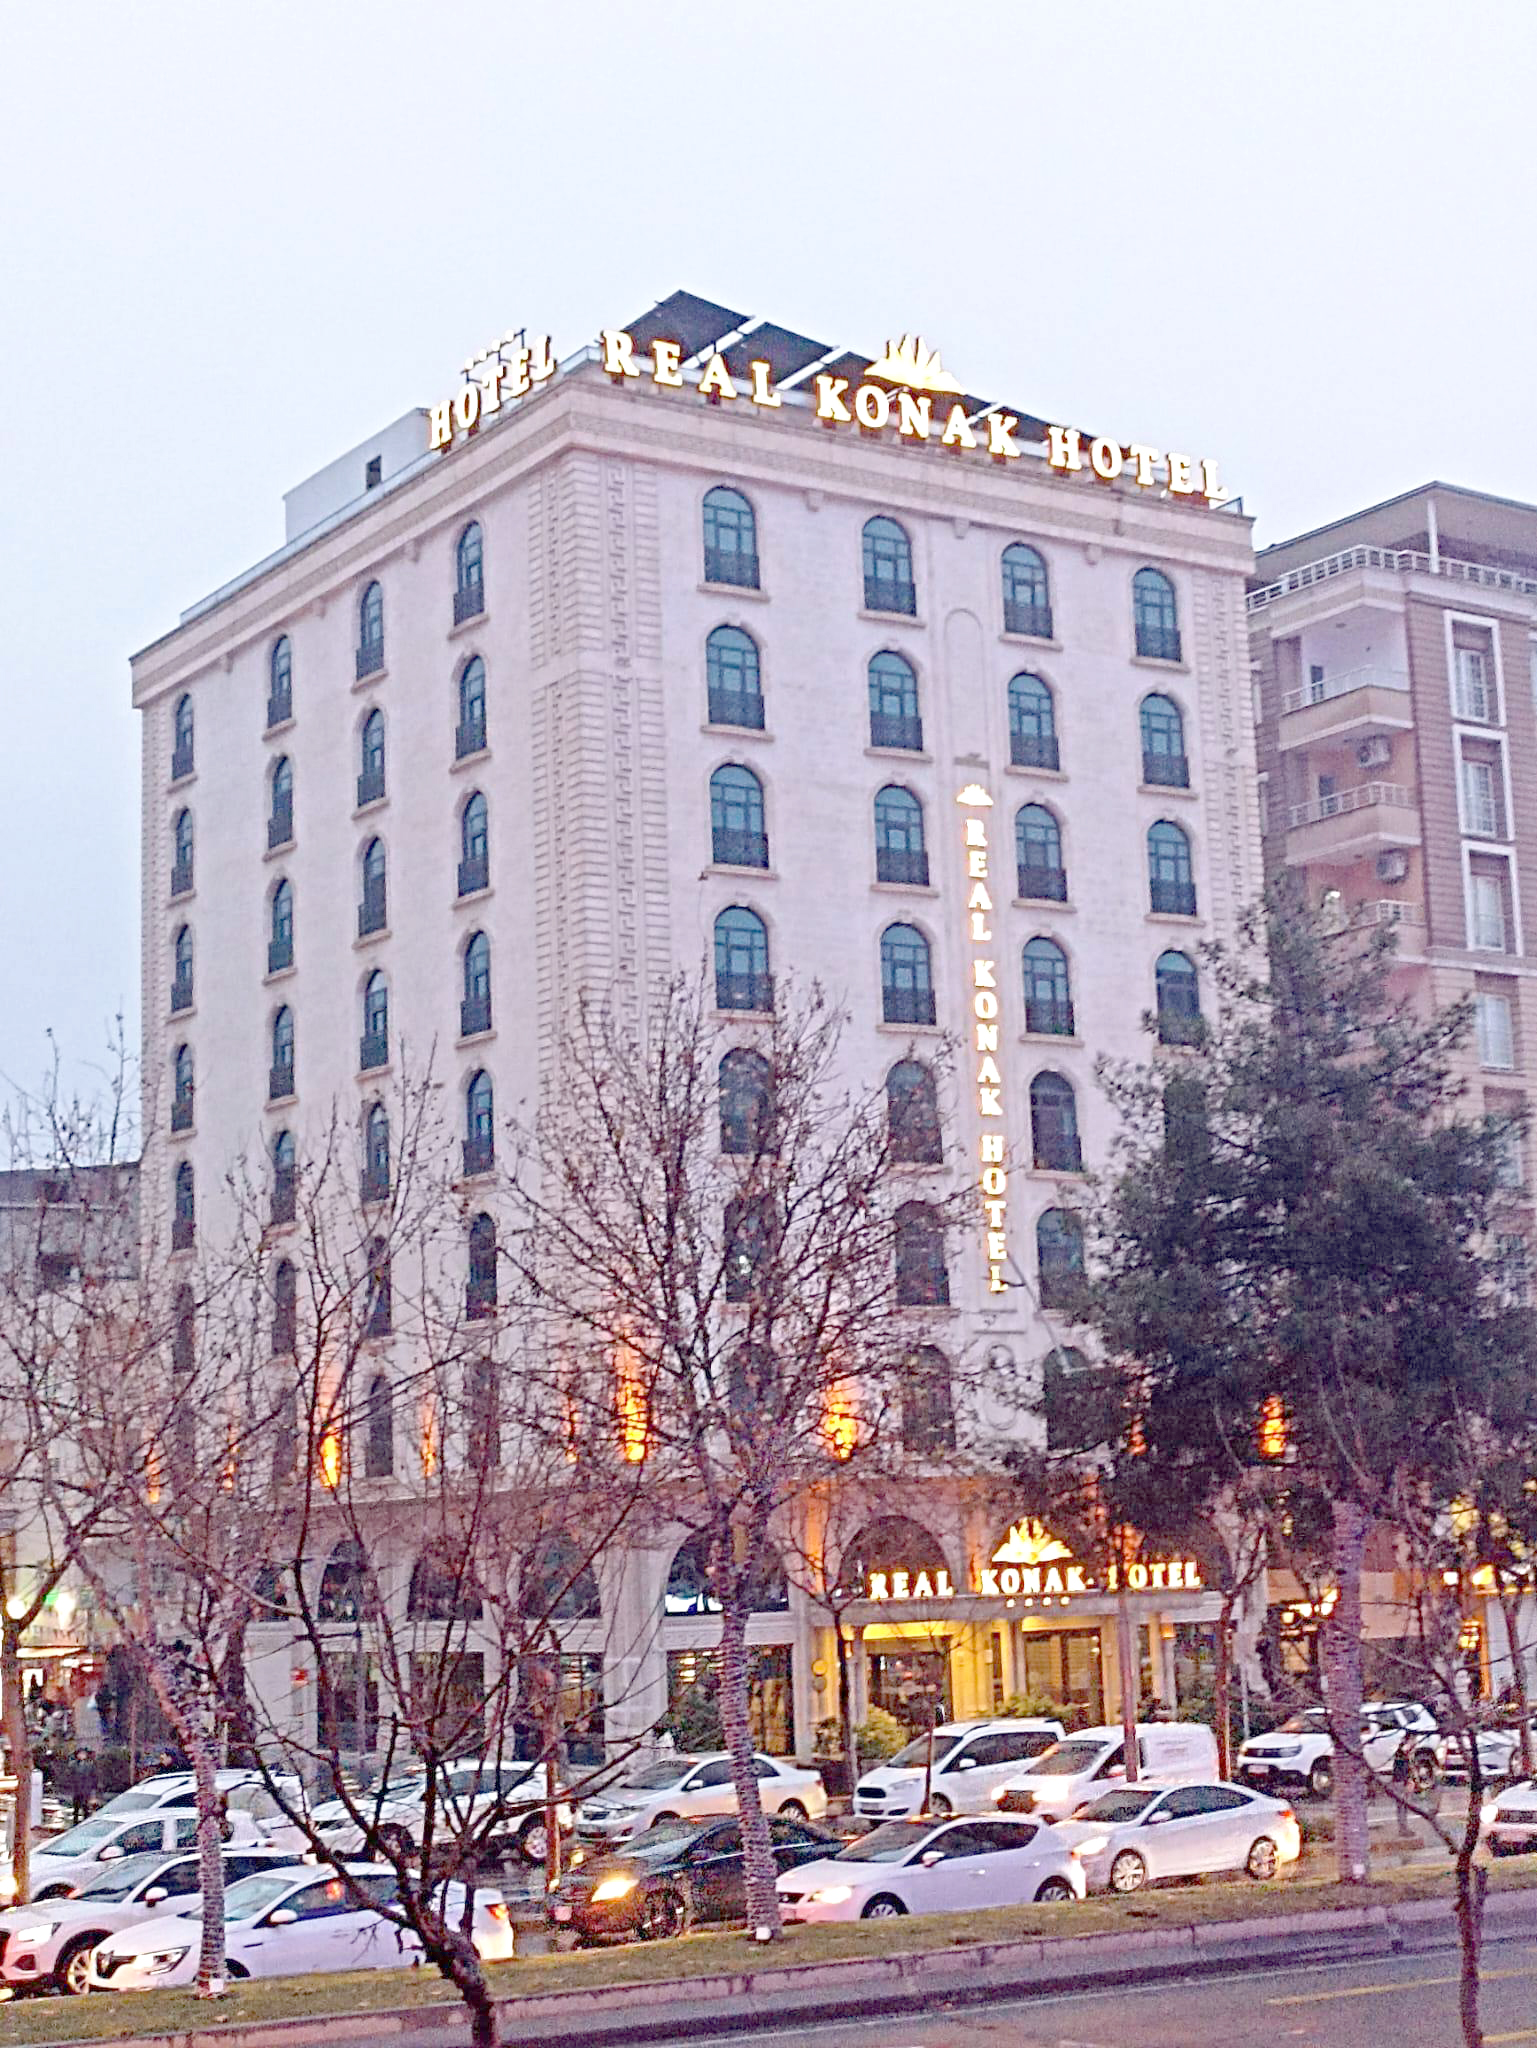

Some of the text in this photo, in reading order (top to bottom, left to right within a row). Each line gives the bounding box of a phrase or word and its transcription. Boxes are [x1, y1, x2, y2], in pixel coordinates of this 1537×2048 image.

[429, 334, 556, 450] HOTEL
[602, 330, 1230, 501] REAL KONAK HOTEL
[965, 818, 1009, 1293] REAL KONAK HOTEL
[869, 1570, 954, 1600] REAL
[980, 1565, 1086, 1595] KONAK
